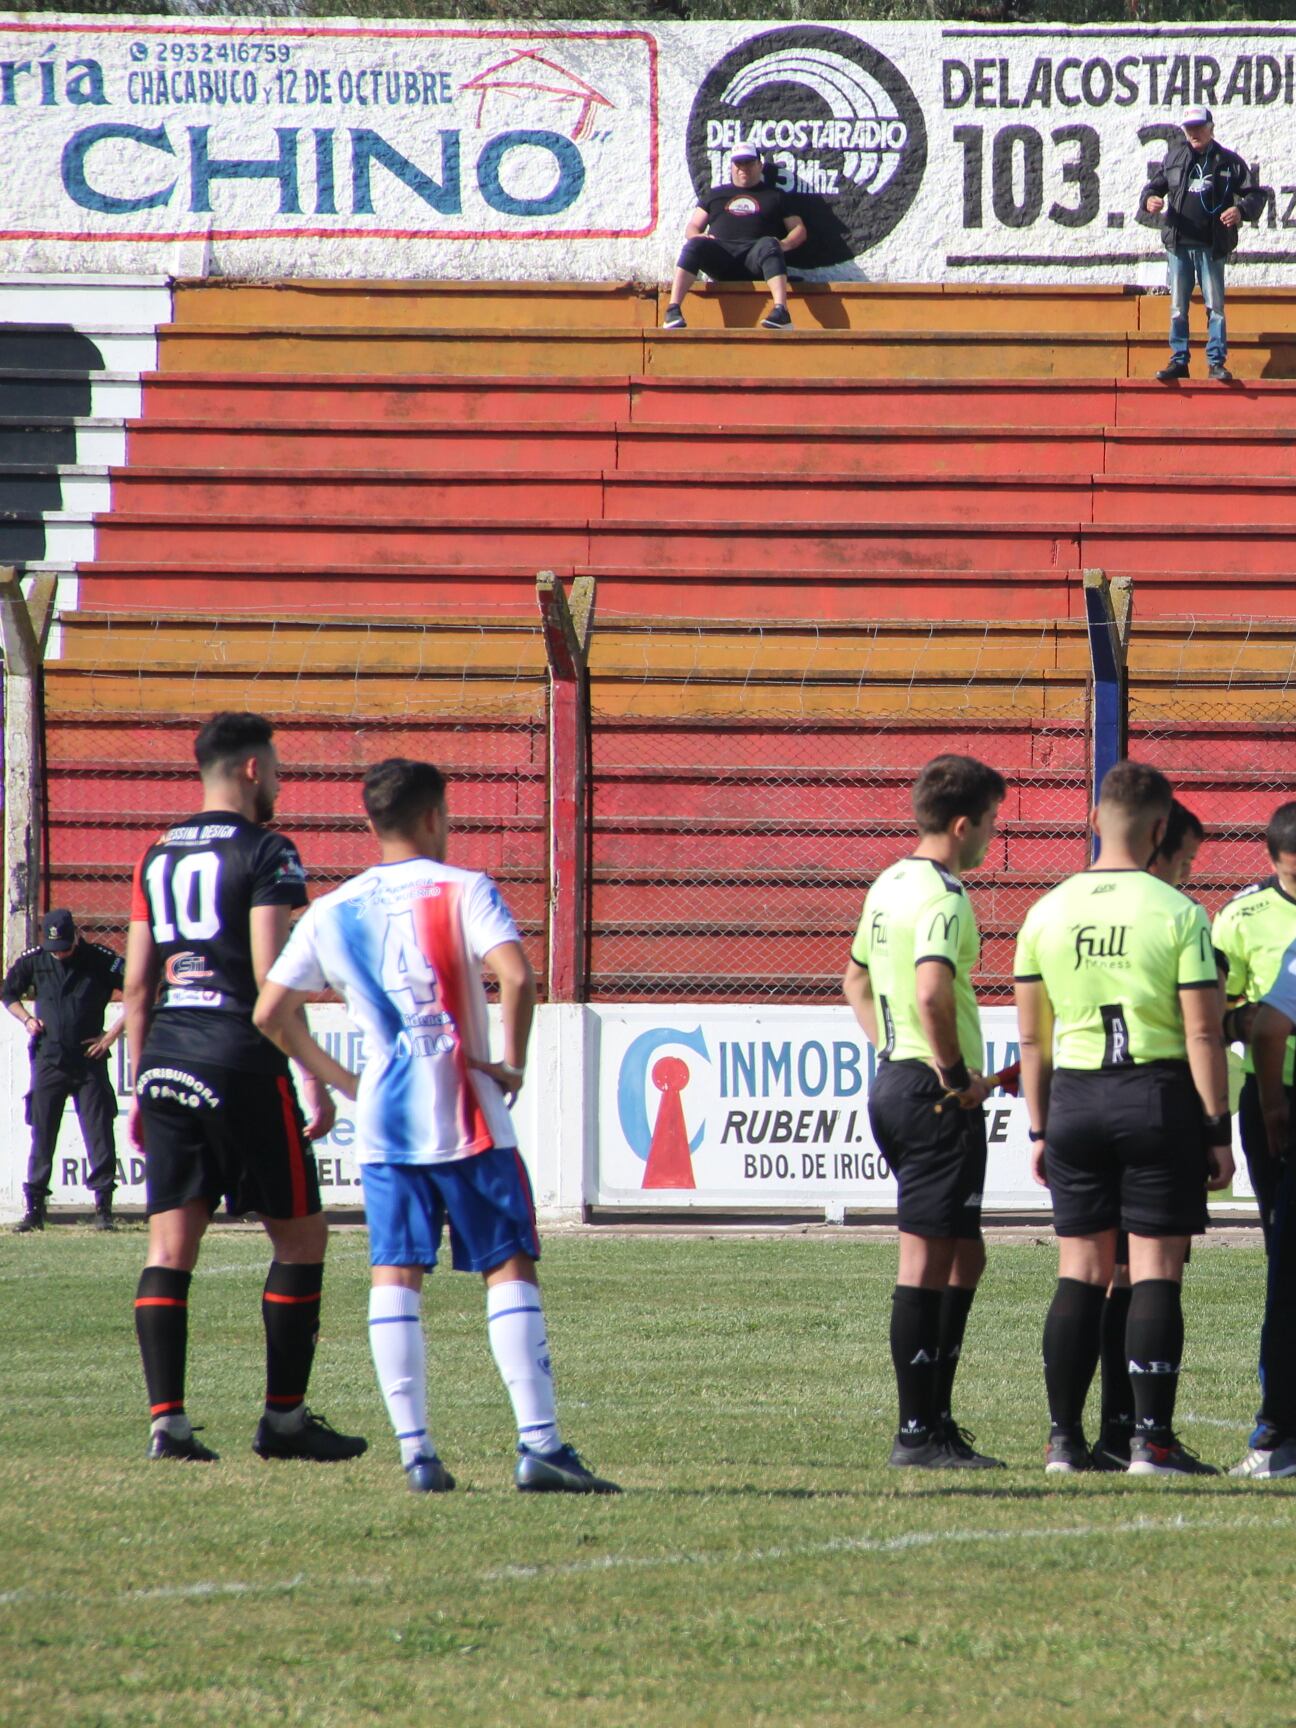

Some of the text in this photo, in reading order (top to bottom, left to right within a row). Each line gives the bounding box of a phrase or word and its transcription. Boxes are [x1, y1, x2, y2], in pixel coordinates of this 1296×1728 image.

[157, 42, 291, 63] 2932416759
[127, 70, 257, 105] CHACABUCO
[276, 68, 298, 104] 12
[305, 69, 332, 104] DE
[338, 70, 452, 105] OCTUBRE
[706, 119, 908, 150] DELACOSTARADIO
[61, 122, 586, 216] CHINO
[201, 824, 237, 839] DESIGN
[146, 851, 220, 943] 10
[379, 909, 436, 1005] 4
[1072, 925, 1132, 971] full
[720, 1109, 838, 1144] RUBEN
[744, 1153, 891, 1179] BDO. DE IRIGO
